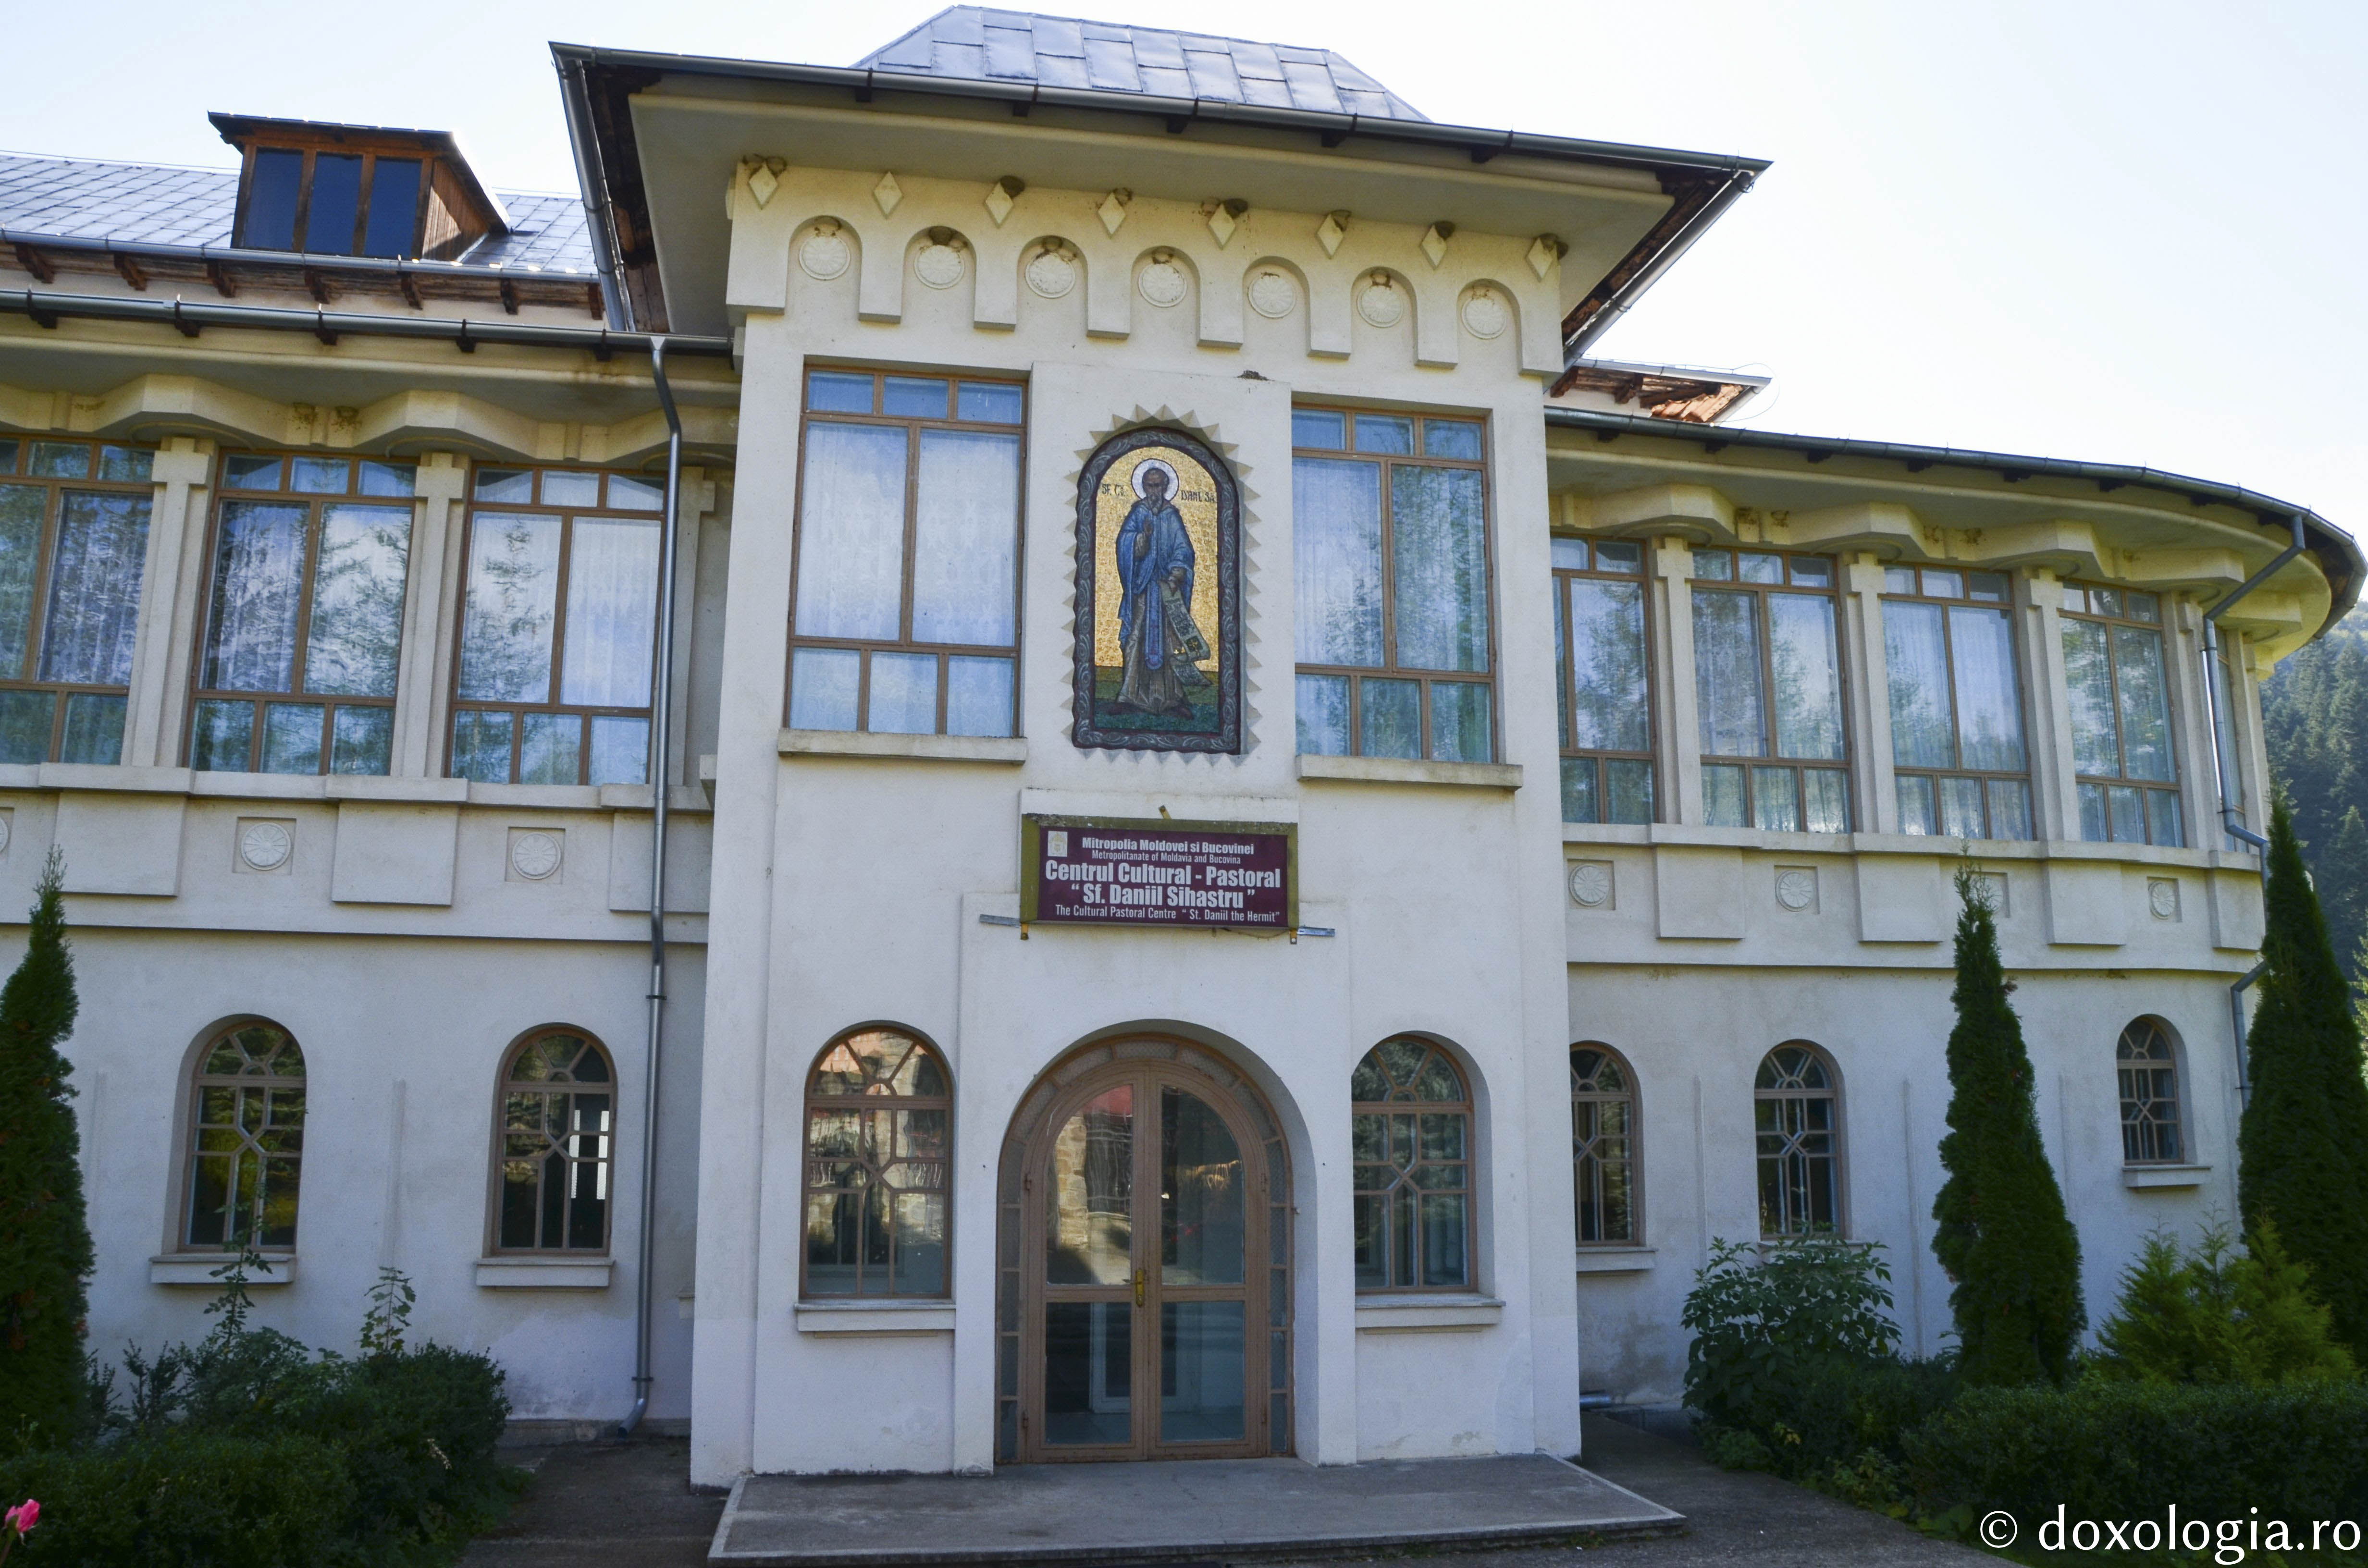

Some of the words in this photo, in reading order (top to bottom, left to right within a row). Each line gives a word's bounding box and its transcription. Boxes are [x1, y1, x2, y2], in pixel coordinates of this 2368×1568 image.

[1082, 837, 1137, 850] Mitropolia
[1139, 839, 1188, 852] Moldovei
[1190, 842, 1200, 853] si
[1202, 842, 1254, 855] Bucovinei
[1092, 850, 1149, 861] Metropolitanate
[1151, 852, 1159, 861] of
[1161, 853, 1192, 862] Moldavia
[1194, 855, 1207, 863] and
[1209, 855, 1241, 864] Bucovina
[1046, 860, 1114, 882] Centrul
[1118, 863, 1191, 884] Cultural
[1206, 866, 1281, 888] Pastoral
[1083, 883, 1105, 904] Sf.
[1110, 884, 1162, 906] Daniil
[1167, 886, 1244, 908] Sihastru
[1055, 905, 1070, 916] The
[1073, 905, 1107, 917] Cultural
[1110, 906, 1145, 918] Pastoral
[1148, 907, 1176, 919] Centre
[1189, 909, 1201, 920] St.
[1205, 909, 1228, 920] Daniil
[1231, 910, 1245, 921] the
